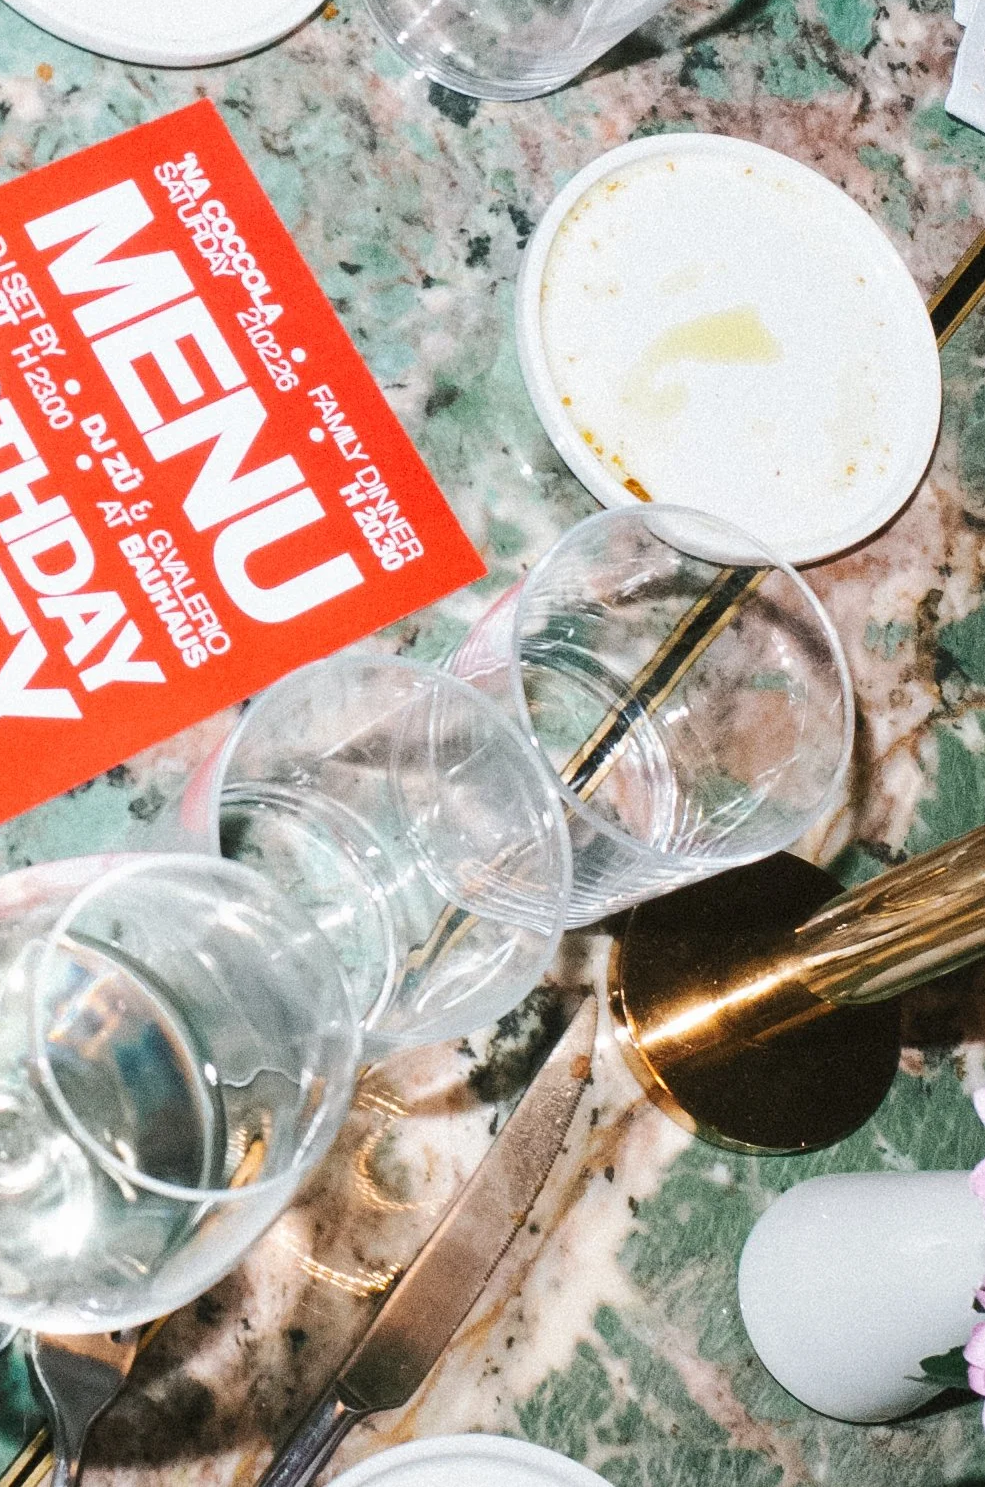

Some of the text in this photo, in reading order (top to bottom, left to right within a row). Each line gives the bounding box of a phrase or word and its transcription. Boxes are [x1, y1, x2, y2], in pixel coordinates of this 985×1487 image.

[1, 272, 45, 320] SET
[29, 323, 66, 356] BY
[79, 413, 117, 453] DJ
[101, 451, 144, 492] ZÜ
[129, 500, 152, 521] &
[146, 529, 231, 655] G.VALERIO
[10, 343, 40, 368] H
[23, 366, 74, 430] 23.00
[23, 178, 364, 624] MENU
[153, 161, 405, 571] SATURDAY 21.02.26 H 20.30
[200, 199, 283, 326] COCCOLA
[307, 384, 369, 461] FAMILY
[354, 465, 424, 562] DINNER
[96, 501, 132, 528] AT
[118, 533, 208, 668] BAUHAUS
